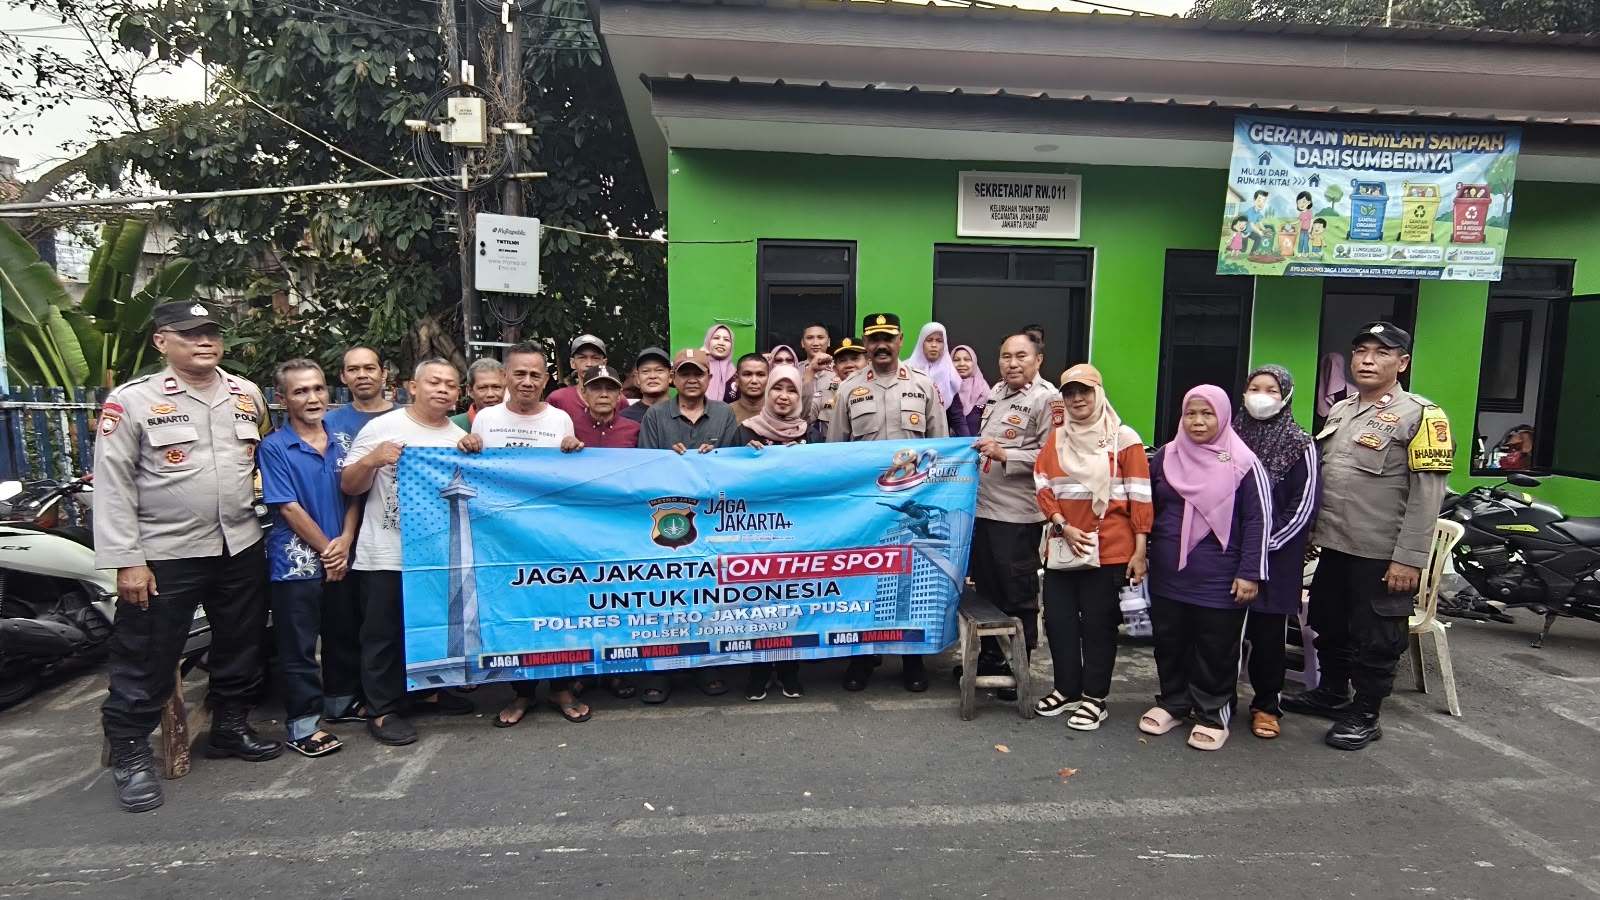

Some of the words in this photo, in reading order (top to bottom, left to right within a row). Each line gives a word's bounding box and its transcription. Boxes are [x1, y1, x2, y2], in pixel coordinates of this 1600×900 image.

[1250, 124, 1338, 145] GERAKAN
[1342, 130, 1426, 149] MEMILAH
[1428, 133, 1505, 151] SAMPAH
[1296, 147, 1340, 167] DARI
[1341, 149, 1452, 171] SUMBERNYA
[1241, 168, 1267, 176] MULAI
[1268, 169, 1289, 177] DARI
[1237, 176, 1267, 186] RUMAH
[1268, 178, 1291, 187] KITA!
[974, 183, 1033, 198] SEKRETARIAT
[1035, 185, 1066, 200] RW.011
[989, 204, 1018, 213] KELURAHAN
[1018, 205, 1034, 213] TANAH
[1034, 205, 1051, 213] TINGGI
[991, 212, 1019, 221] KECAMATAN
[1019, 213, 1035, 221] JOHAR
[1036, 213, 1048, 221] BARU
[1001, 220, 1022, 229] JAKARTA
[1023, 221, 1038, 229] PUSAT
[1010, 403, 1032, 414] POLRI
[147, 414, 190, 426] SUNARTO
[234, 413, 257, 423] POLR
[1366, 419, 1396, 434] POLRI
[883, 448, 938, 482] 80
[928, 467, 960, 478] POLRI
[650, 497, 678, 506] METRO
[679, 497, 698, 505] JAYA
[704, 497, 747, 516] JAGA
[510, 566, 588, 586] JAGA
[592, 560, 717, 583] JAKARTA
[727, 557, 772, 577] ON
[776, 555, 828, 575] THE
[830, 551, 902, 571] SPOT
[588, 589, 687, 610] UNTUK
[692, 581, 841, 606] INDONESIA
[533, 615, 622, 632] POLRES
[627, 611, 703, 627] METRO
[708, 605, 805, 623] JAKARTA
[809, 600, 875, 614] PUSAT
[631, 628, 691, 640] POLSEK
[694, 624, 746, 637] JOHAR
[750, 620, 788, 633] BARU
[833, 632, 860, 645] JAGA
[861, 630, 903, 643] AMANAH
[725, 639, 752, 652] JAGA
[754, 636, 793, 650] ATURAN
[490, 655, 520, 668] JAGA
[522, 649, 591, 667] LINGKUNGAN
[610, 647, 639, 660] JAGA
[641, 645, 680, 657] WARGA
